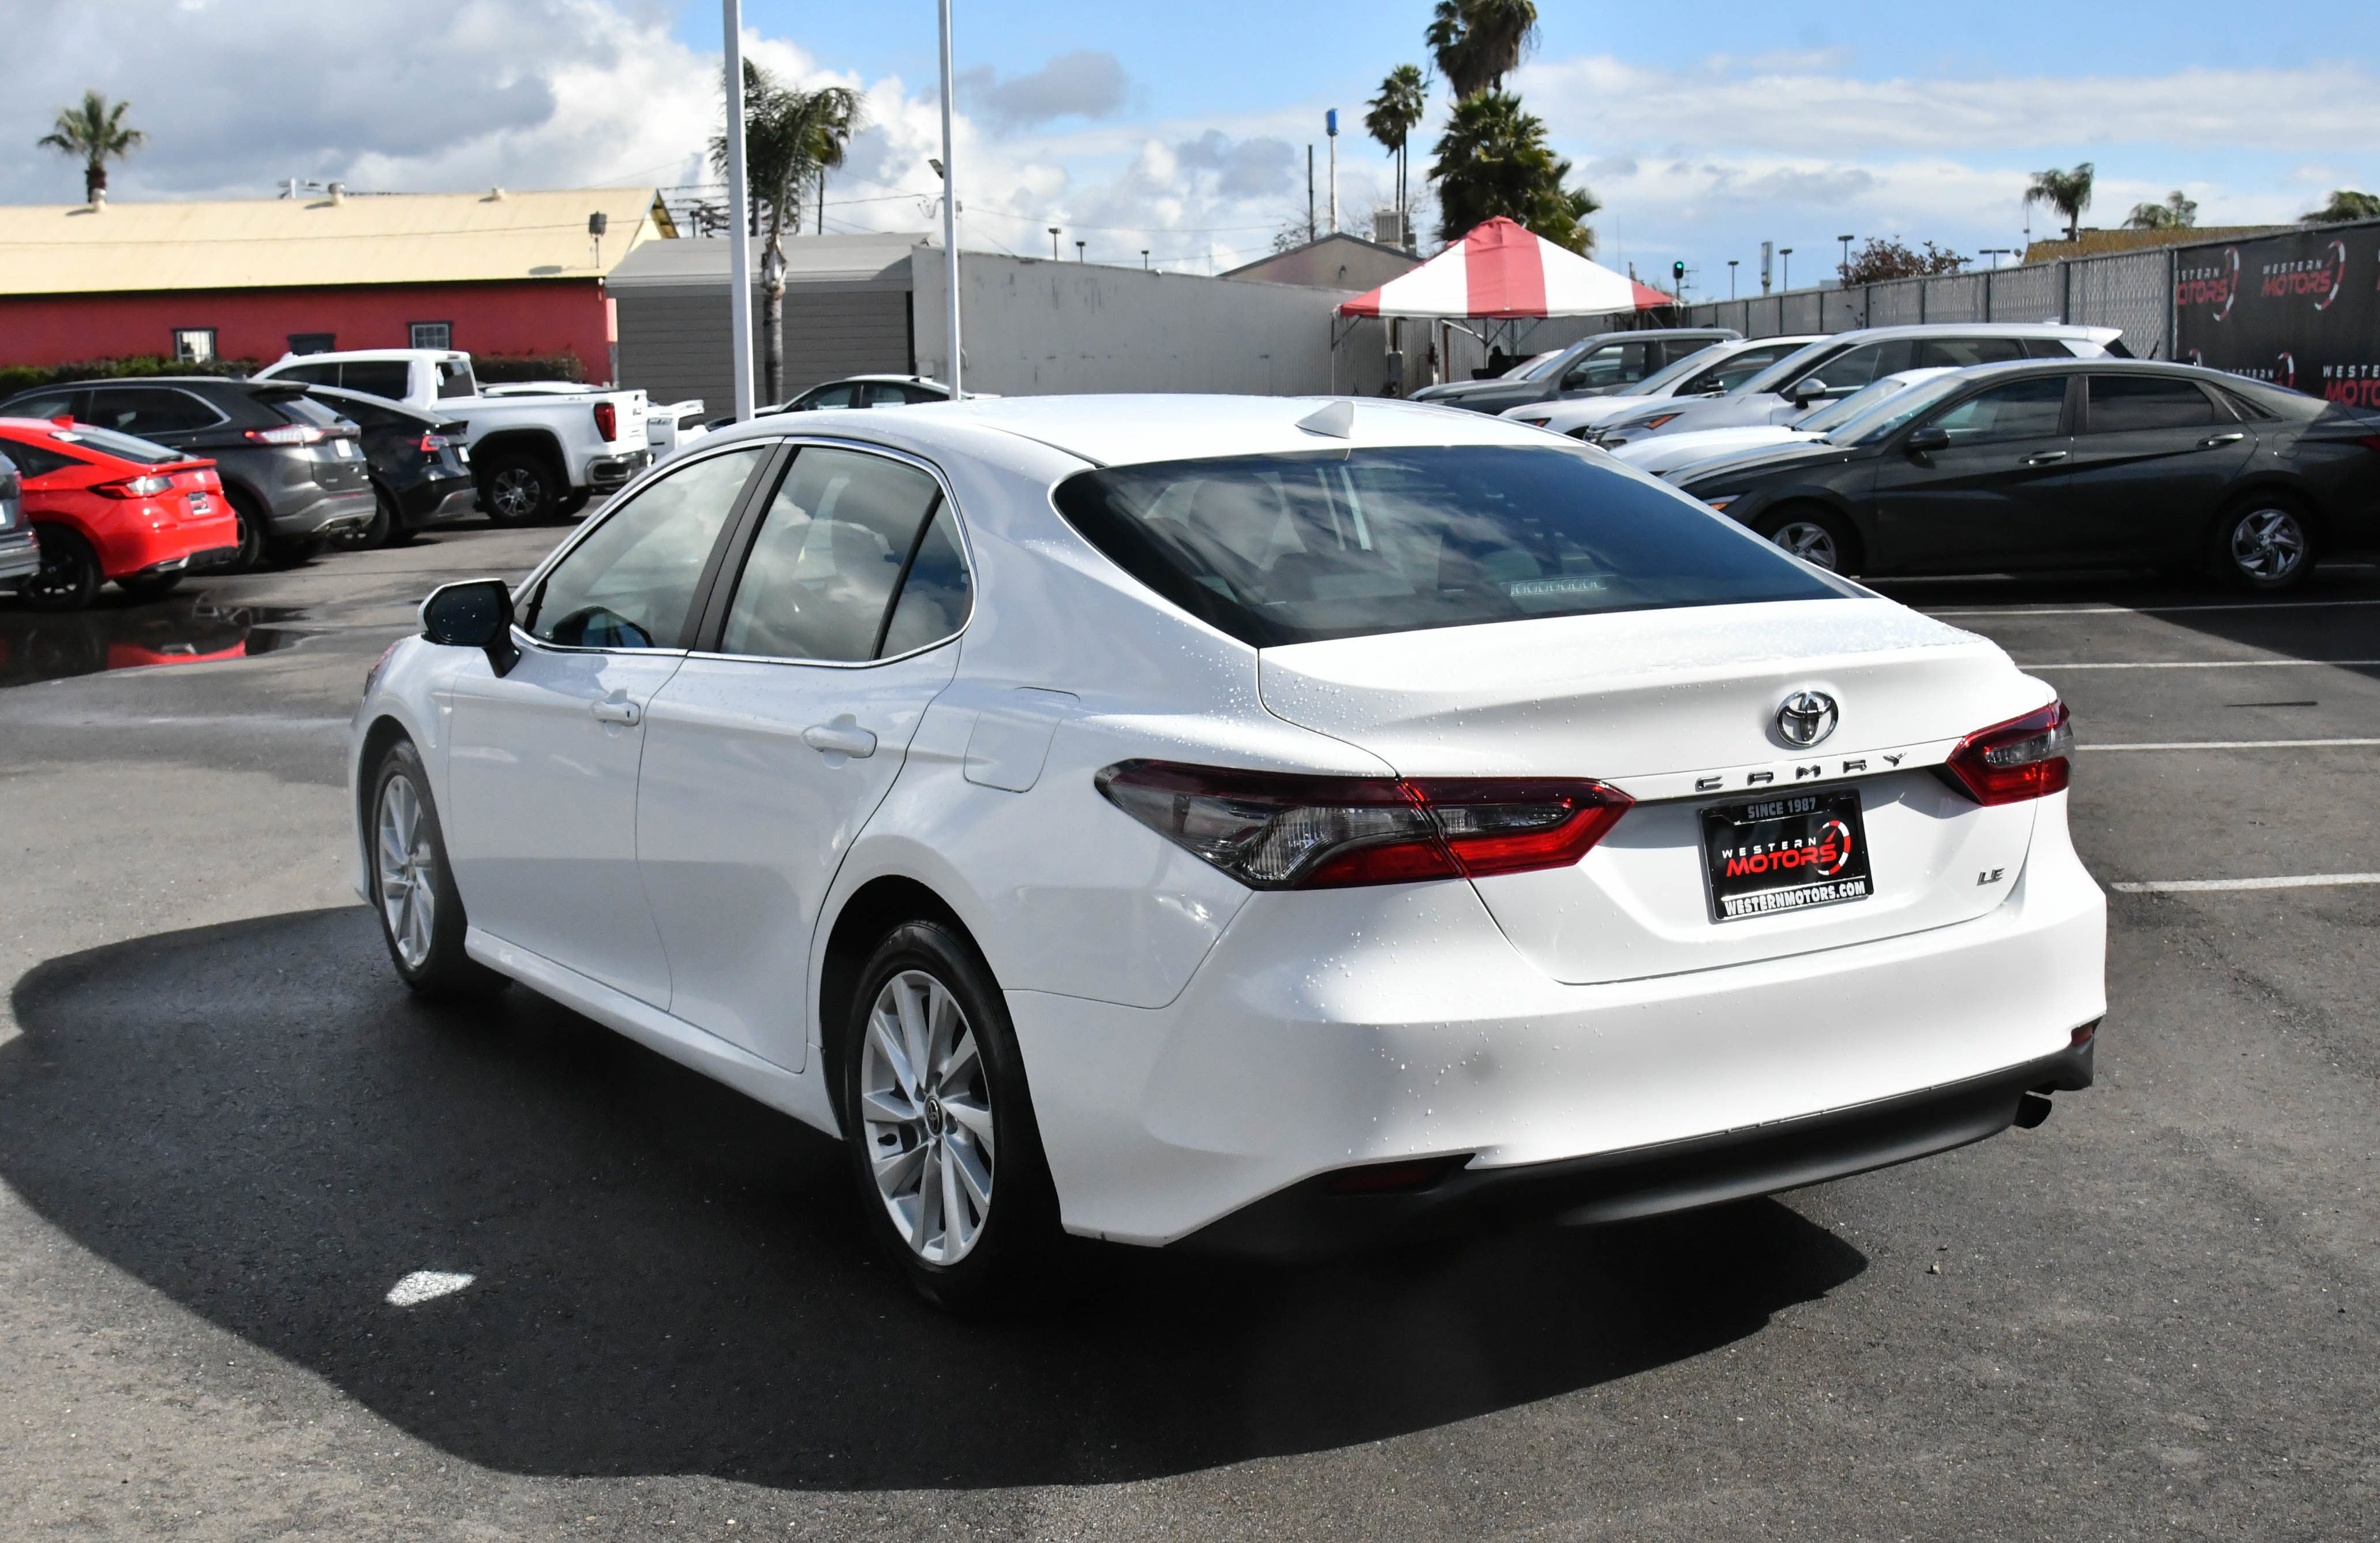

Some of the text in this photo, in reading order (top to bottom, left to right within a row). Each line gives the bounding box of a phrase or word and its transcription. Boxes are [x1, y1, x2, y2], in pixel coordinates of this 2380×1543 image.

[2177, 267, 2220, 282] STERN
[2263, 259, 2323, 274] WESTERN
[2176, 279, 2228, 305] OTORS
[2262, 270, 2332, 297] MOTORS
[2323, 364, 2380, 378] WESTE
[2325, 379, 2380, 406] MOTO
[1696, 753, 1907, 791] CAMRY
[1747, 797, 1816, 819] SINCE 1987
[1722, 836, 1816, 859] WESTERN
[1726, 843, 1837, 877] MOTORS
[1976, 868, 2005, 886] LE
[1724, 880, 1866, 916] WESTERNMOTORS.COM
